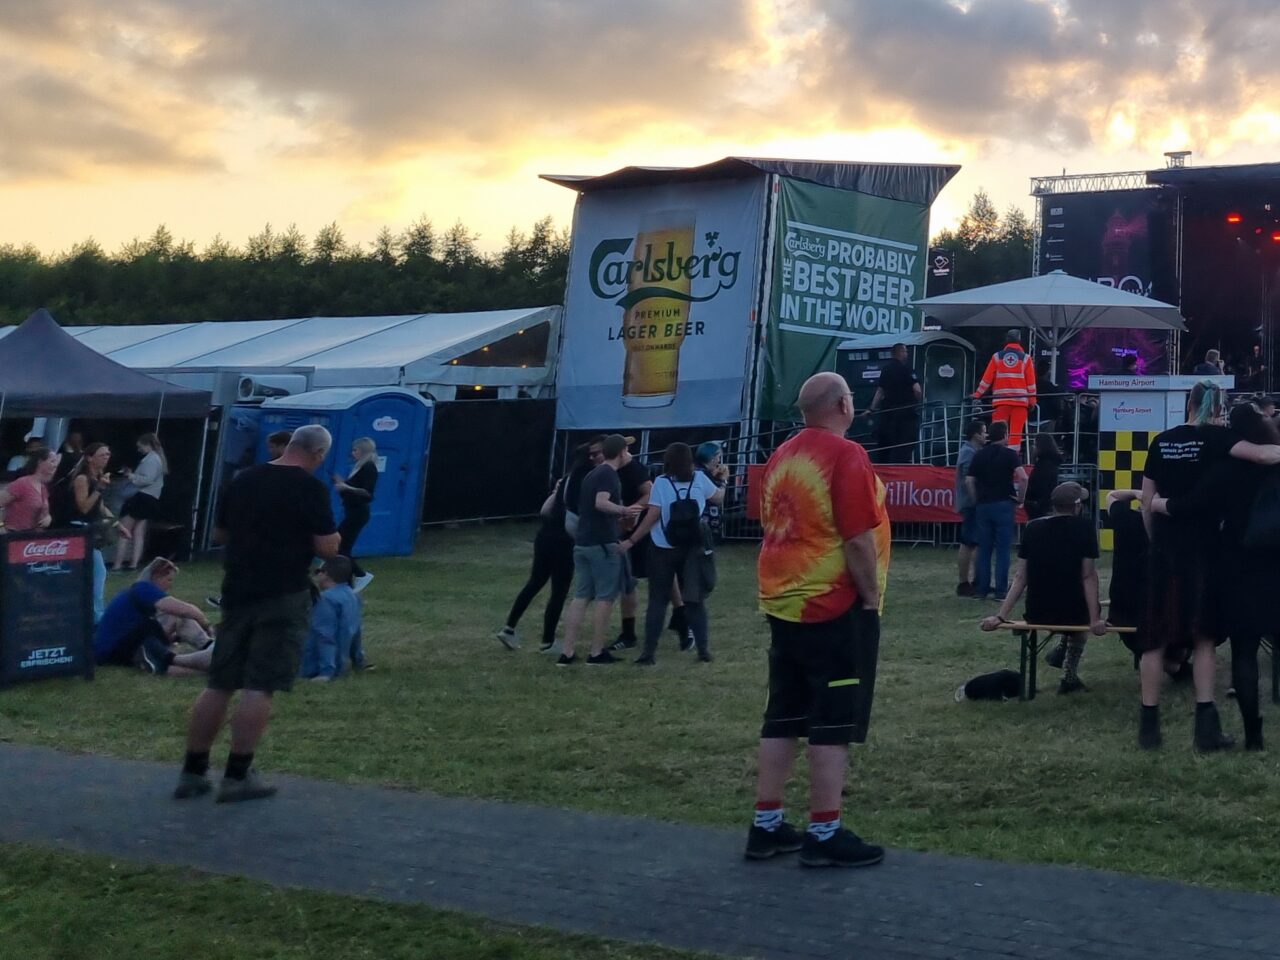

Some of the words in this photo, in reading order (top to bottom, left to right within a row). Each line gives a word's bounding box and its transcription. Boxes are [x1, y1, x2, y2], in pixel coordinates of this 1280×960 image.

[784, 230, 826, 260] Carlsberg
[827, 239, 917, 276] PROBABLY
[588, 233, 741, 309] Carlsberg
[782, 257, 793, 288] THE
[793, 259, 857, 299] BEST
[857, 270, 915, 309] BEER
[634, 308, 681, 320] PREMIUM
[780, 293, 799, 321] IN
[803, 296, 842, 326] THE
[845, 302, 914, 334] WORLD
[608, 323, 658, 341] LAGER
[663, 319, 705, 338] BEER
[1098, 379, 1130, 387] Hamburg
[1131, 379, 1155, 387] Airport
[1112, 407, 1135, 415] Hamburg
[1134, 407, 1152, 415] Airport
[885, 480, 953, 507] illkom
[23, 540, 69, 558] Coca-Cola
[28, 646, 67, 660] JETZT
